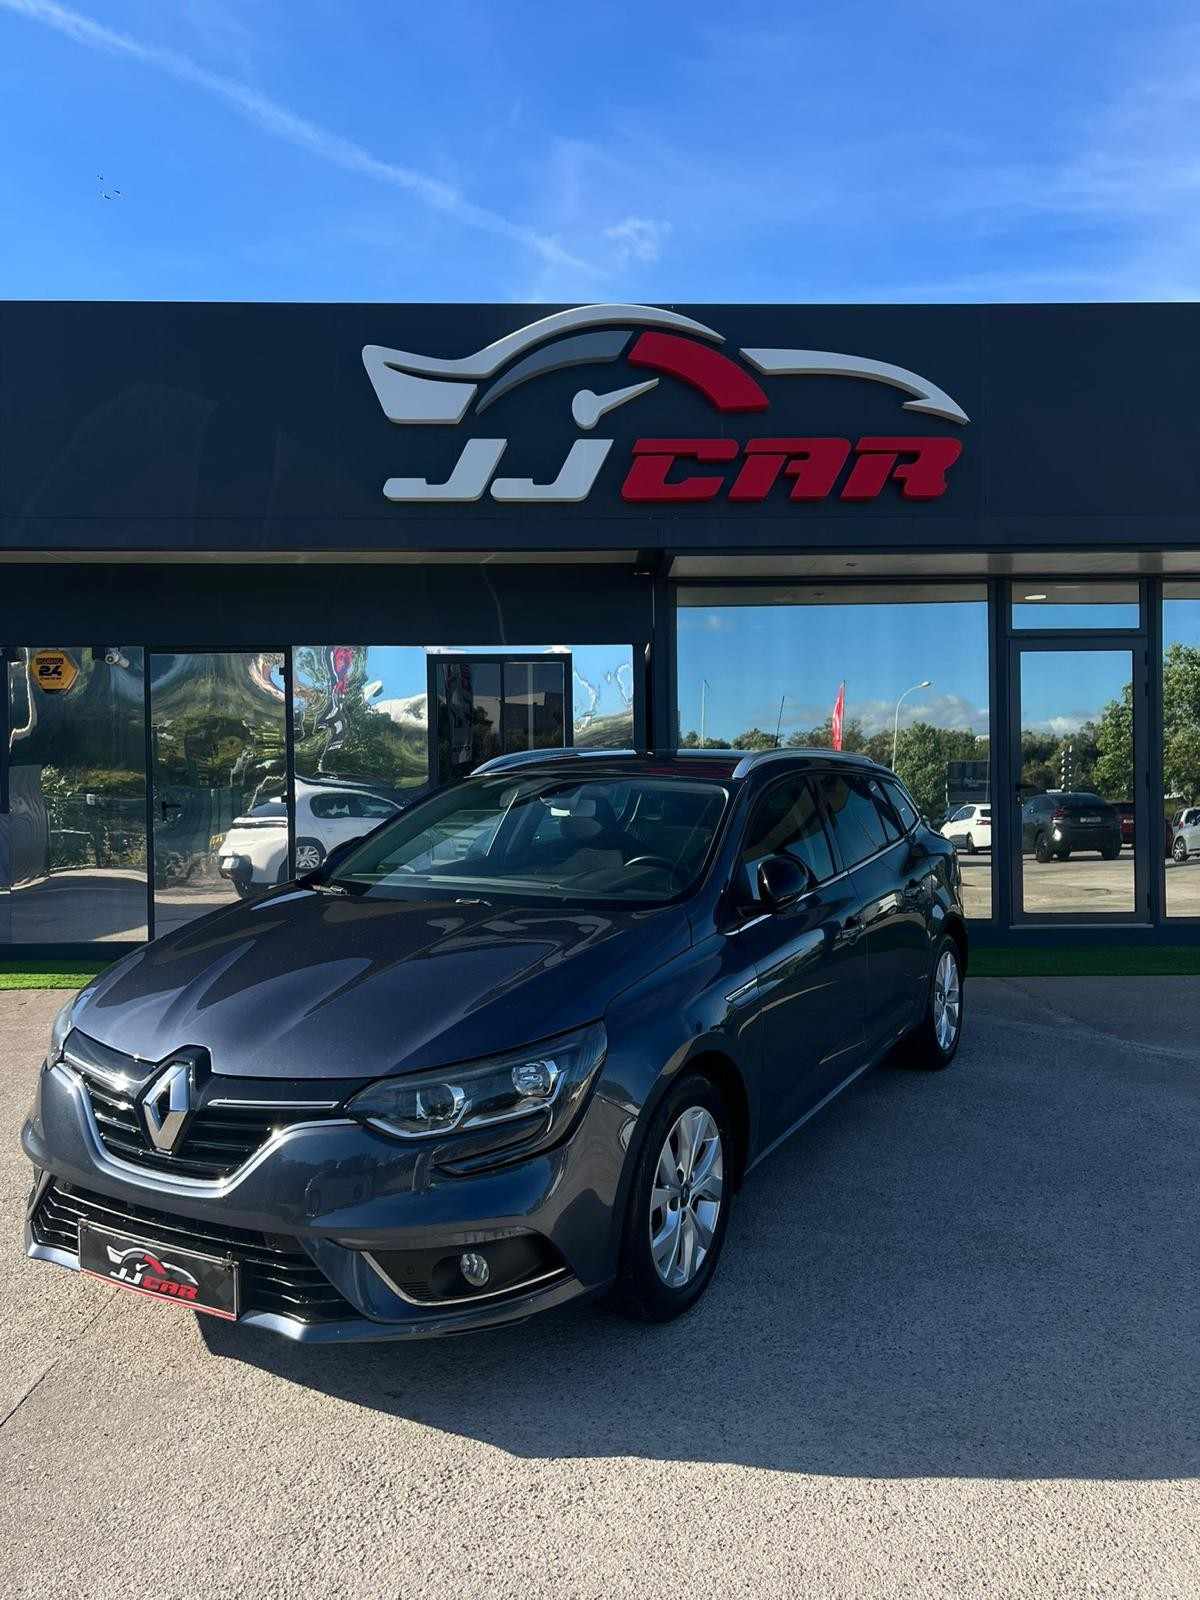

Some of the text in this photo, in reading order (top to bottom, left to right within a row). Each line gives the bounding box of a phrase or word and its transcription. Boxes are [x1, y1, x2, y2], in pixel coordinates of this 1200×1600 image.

[383, 437, 963, 502] JJ CAR
[38, 665, 63, 677] 24
[109, 1267, 198, 1300] JJ CAR
